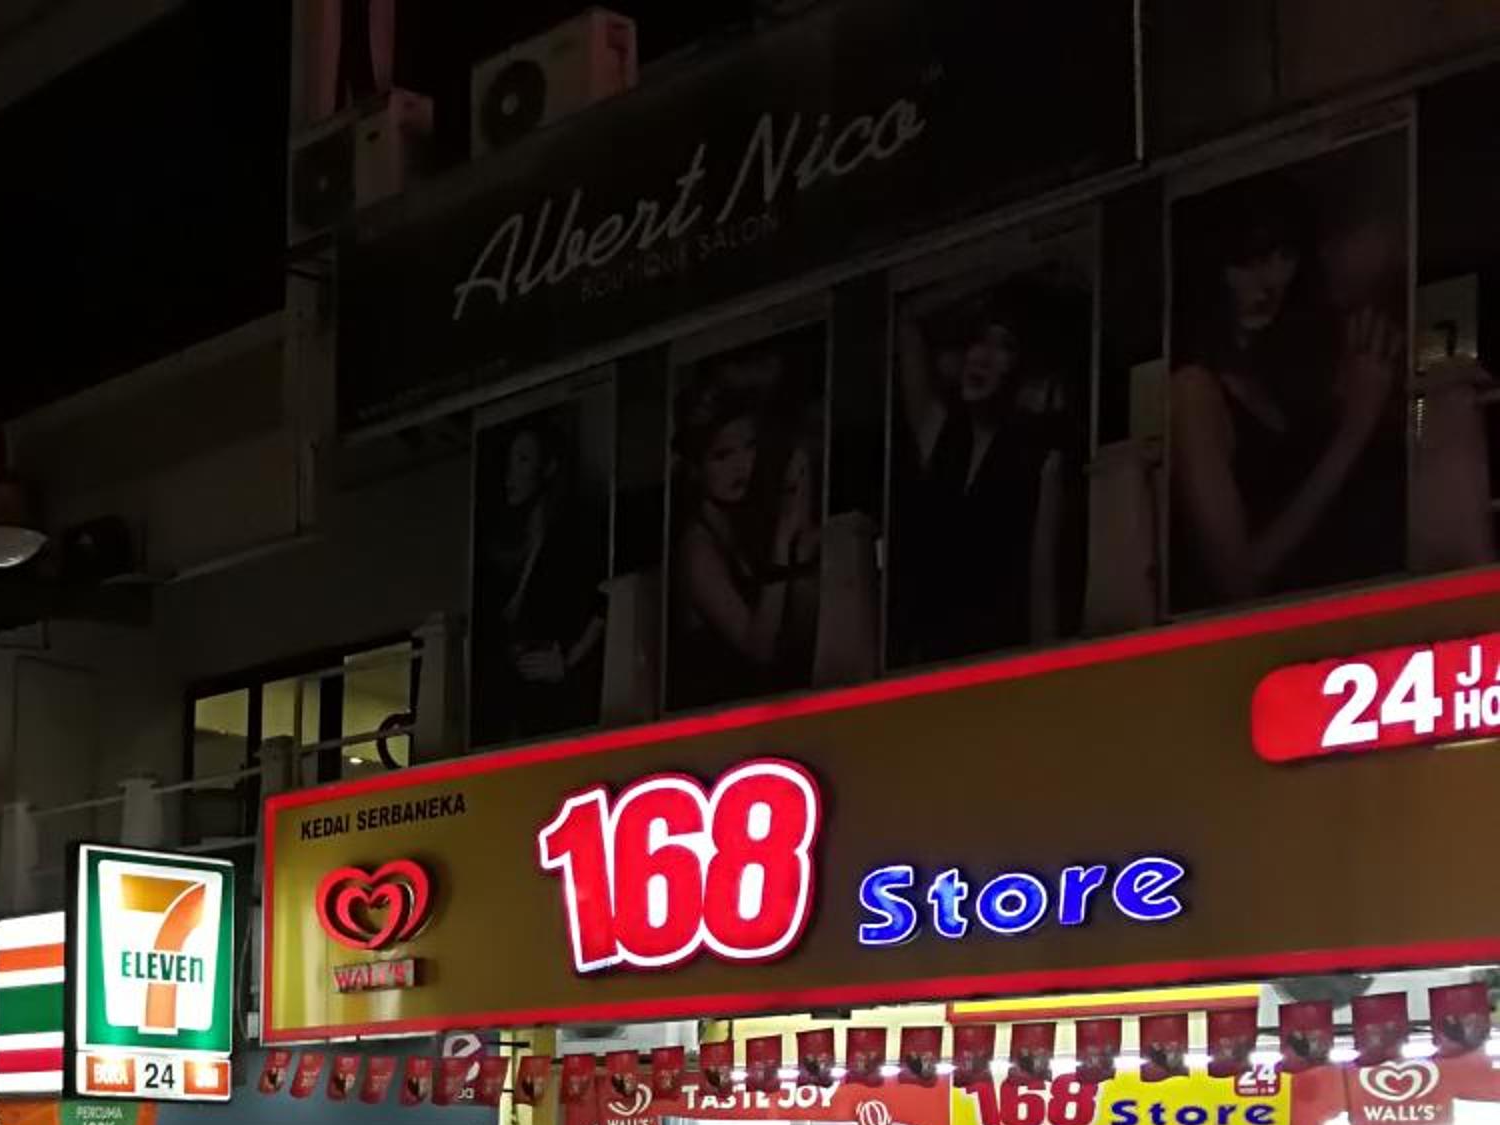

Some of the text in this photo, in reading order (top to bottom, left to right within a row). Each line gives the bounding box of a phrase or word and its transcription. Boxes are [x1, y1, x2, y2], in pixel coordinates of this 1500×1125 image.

[708, 95, 926, 222] Nico
[1321, 649, 1443, 747] 24
[301, 794, 466, 841] KEDAI SERBANEKA
[539, 762, 1186, 974] 168 Store
[145, 1063, 175, 1088] 24
[778, 1081, 840, 1109] JOY
[1363, 1106, 1436, 1122] WALL'S
